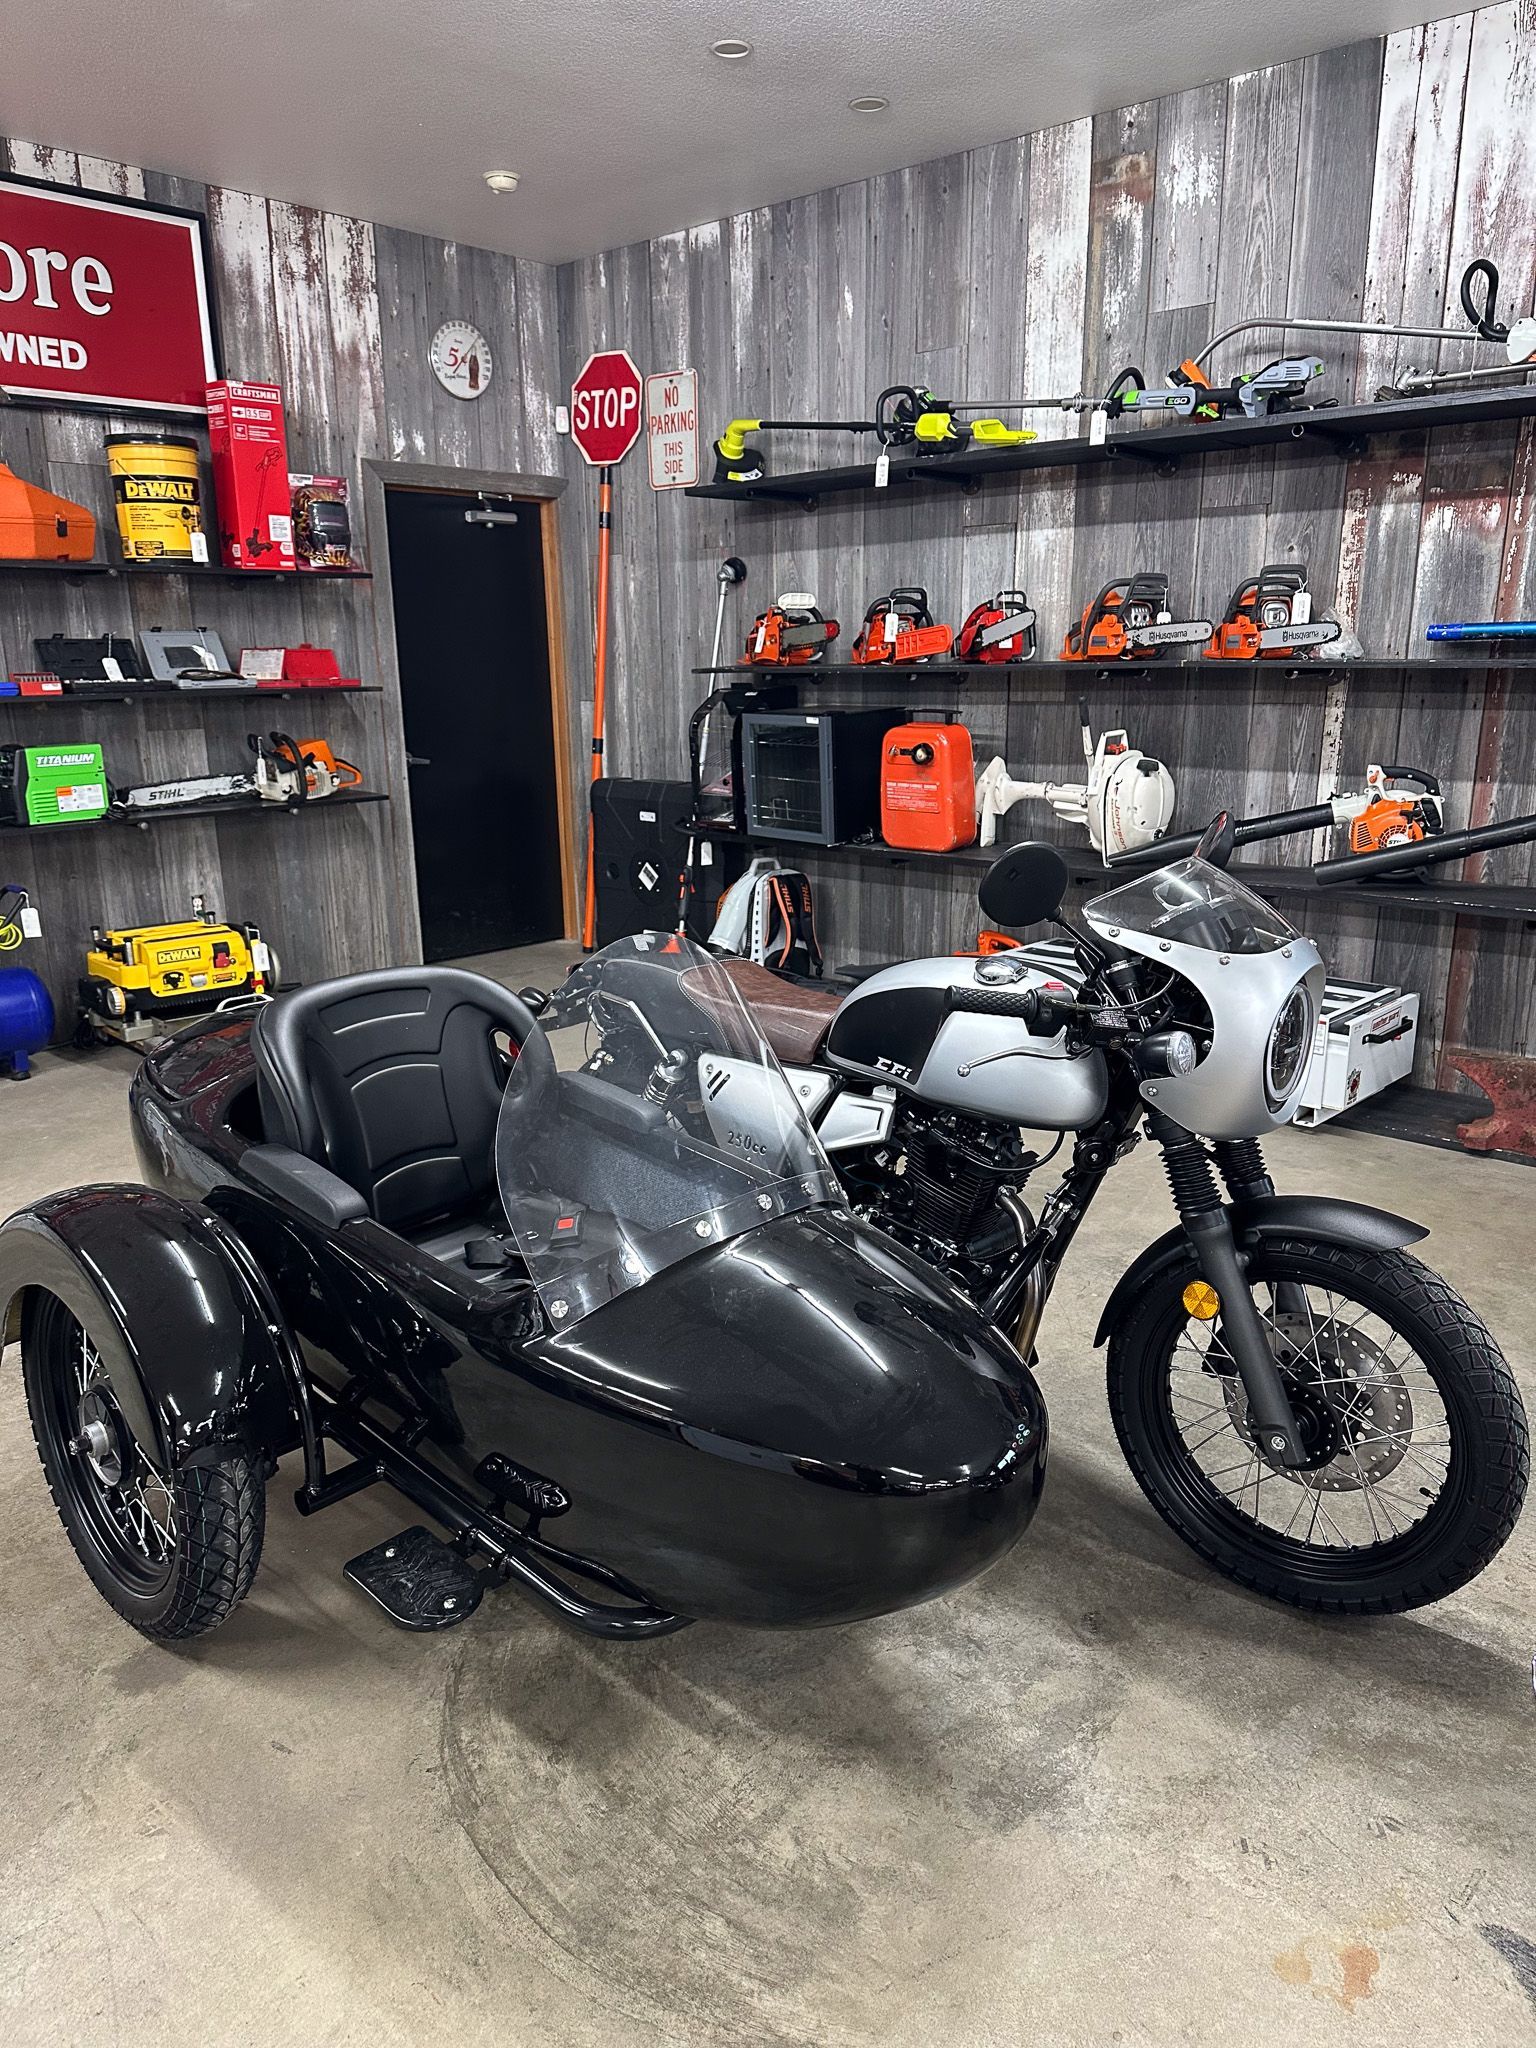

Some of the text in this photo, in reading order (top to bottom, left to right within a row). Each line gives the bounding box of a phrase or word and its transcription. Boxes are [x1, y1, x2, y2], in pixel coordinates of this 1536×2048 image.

[232, 387, 278, 400] CRAFTSMAN
[664, 386, 679, 409] NO
[1167, 397, 1188, 405] EGO
[576, 387, 637, 431] STOP
[650, 409, 694, 436] PARKING
[663, 442, 683, 457] THIS
[664, 460, 684, 474] SIDE
[1155, 630, 1188, 640] Husqvarna
[1289, 630, 1320, 640] Husqvarna
[36, 754, 95, 767] TITANIUM
[148, 788, 185, 801] STIHL
[1114, 799, 1128, 850] Johnson
[727, 1130, 768, 1156] 250cc
